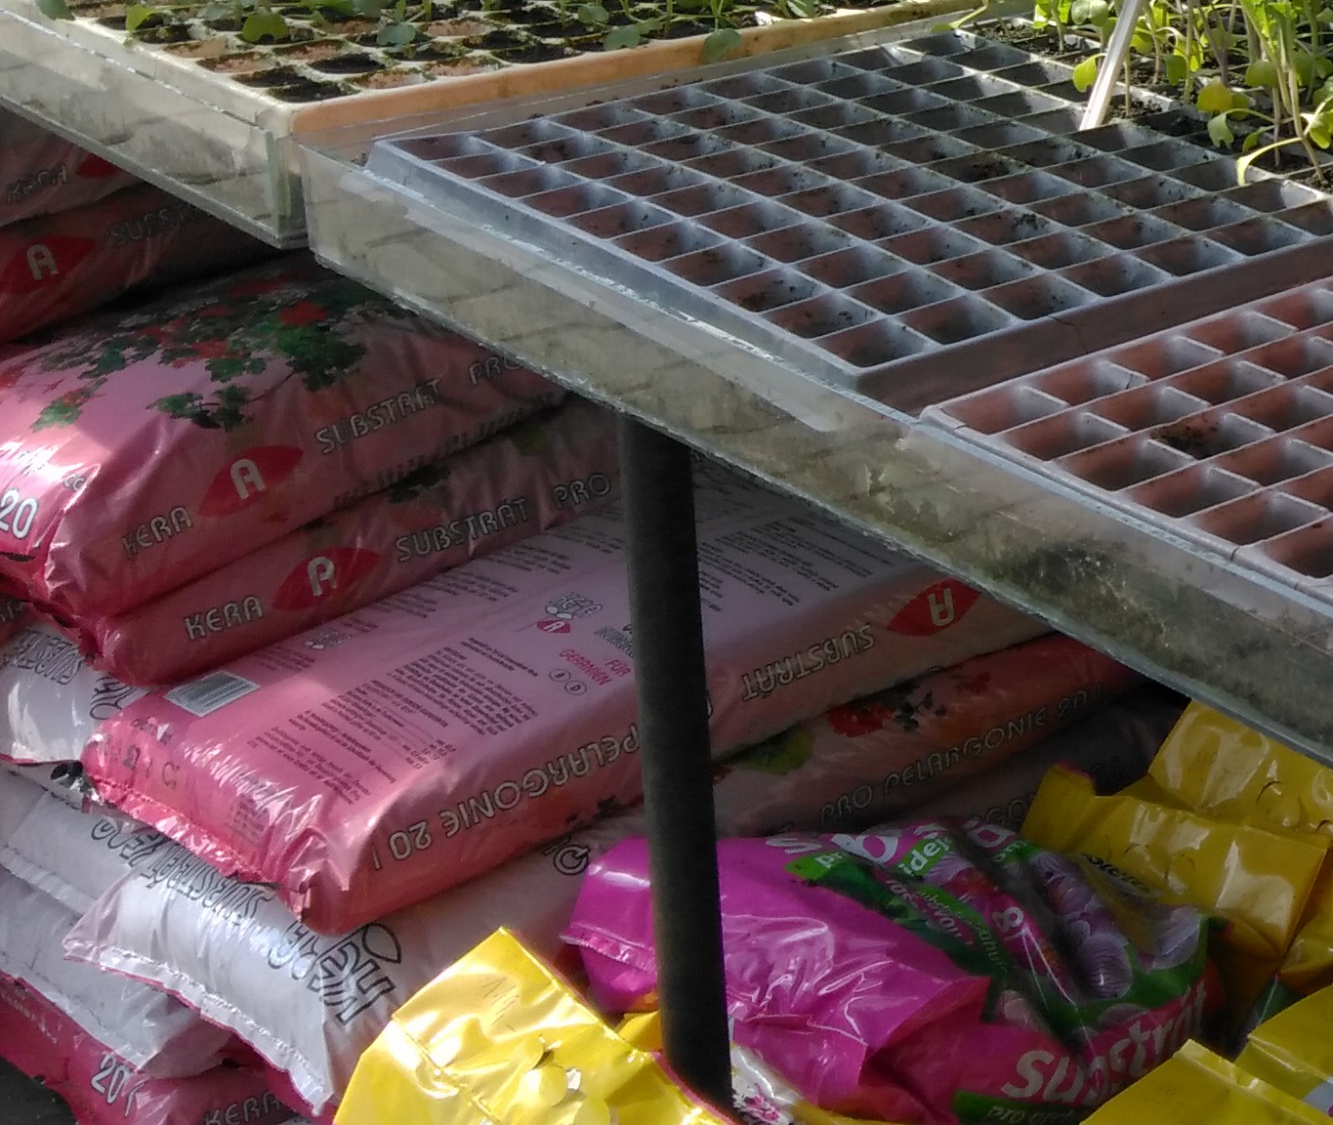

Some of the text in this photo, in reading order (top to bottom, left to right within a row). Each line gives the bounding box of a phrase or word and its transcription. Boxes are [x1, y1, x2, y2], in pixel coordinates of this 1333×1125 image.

[121, 505, 193, 559] KERA
[315, 377, 442, 456] SUBSTRÁT
[183, 594, 265, 643] KERA
[394, 492, 530, 563] SUBSTRÁT
[553, 471, 613, 512] PRO
[742, 621, 876, 702] SUBSTRÁT
[440, 722, 642, 838] PELARGONIE
[819, 784, 875, 828] PRO
[883, 705, 1050, 796] PELARGONIE
[389, 820, 432, 860] 20
[90, 1052, 132, 1105] 20
